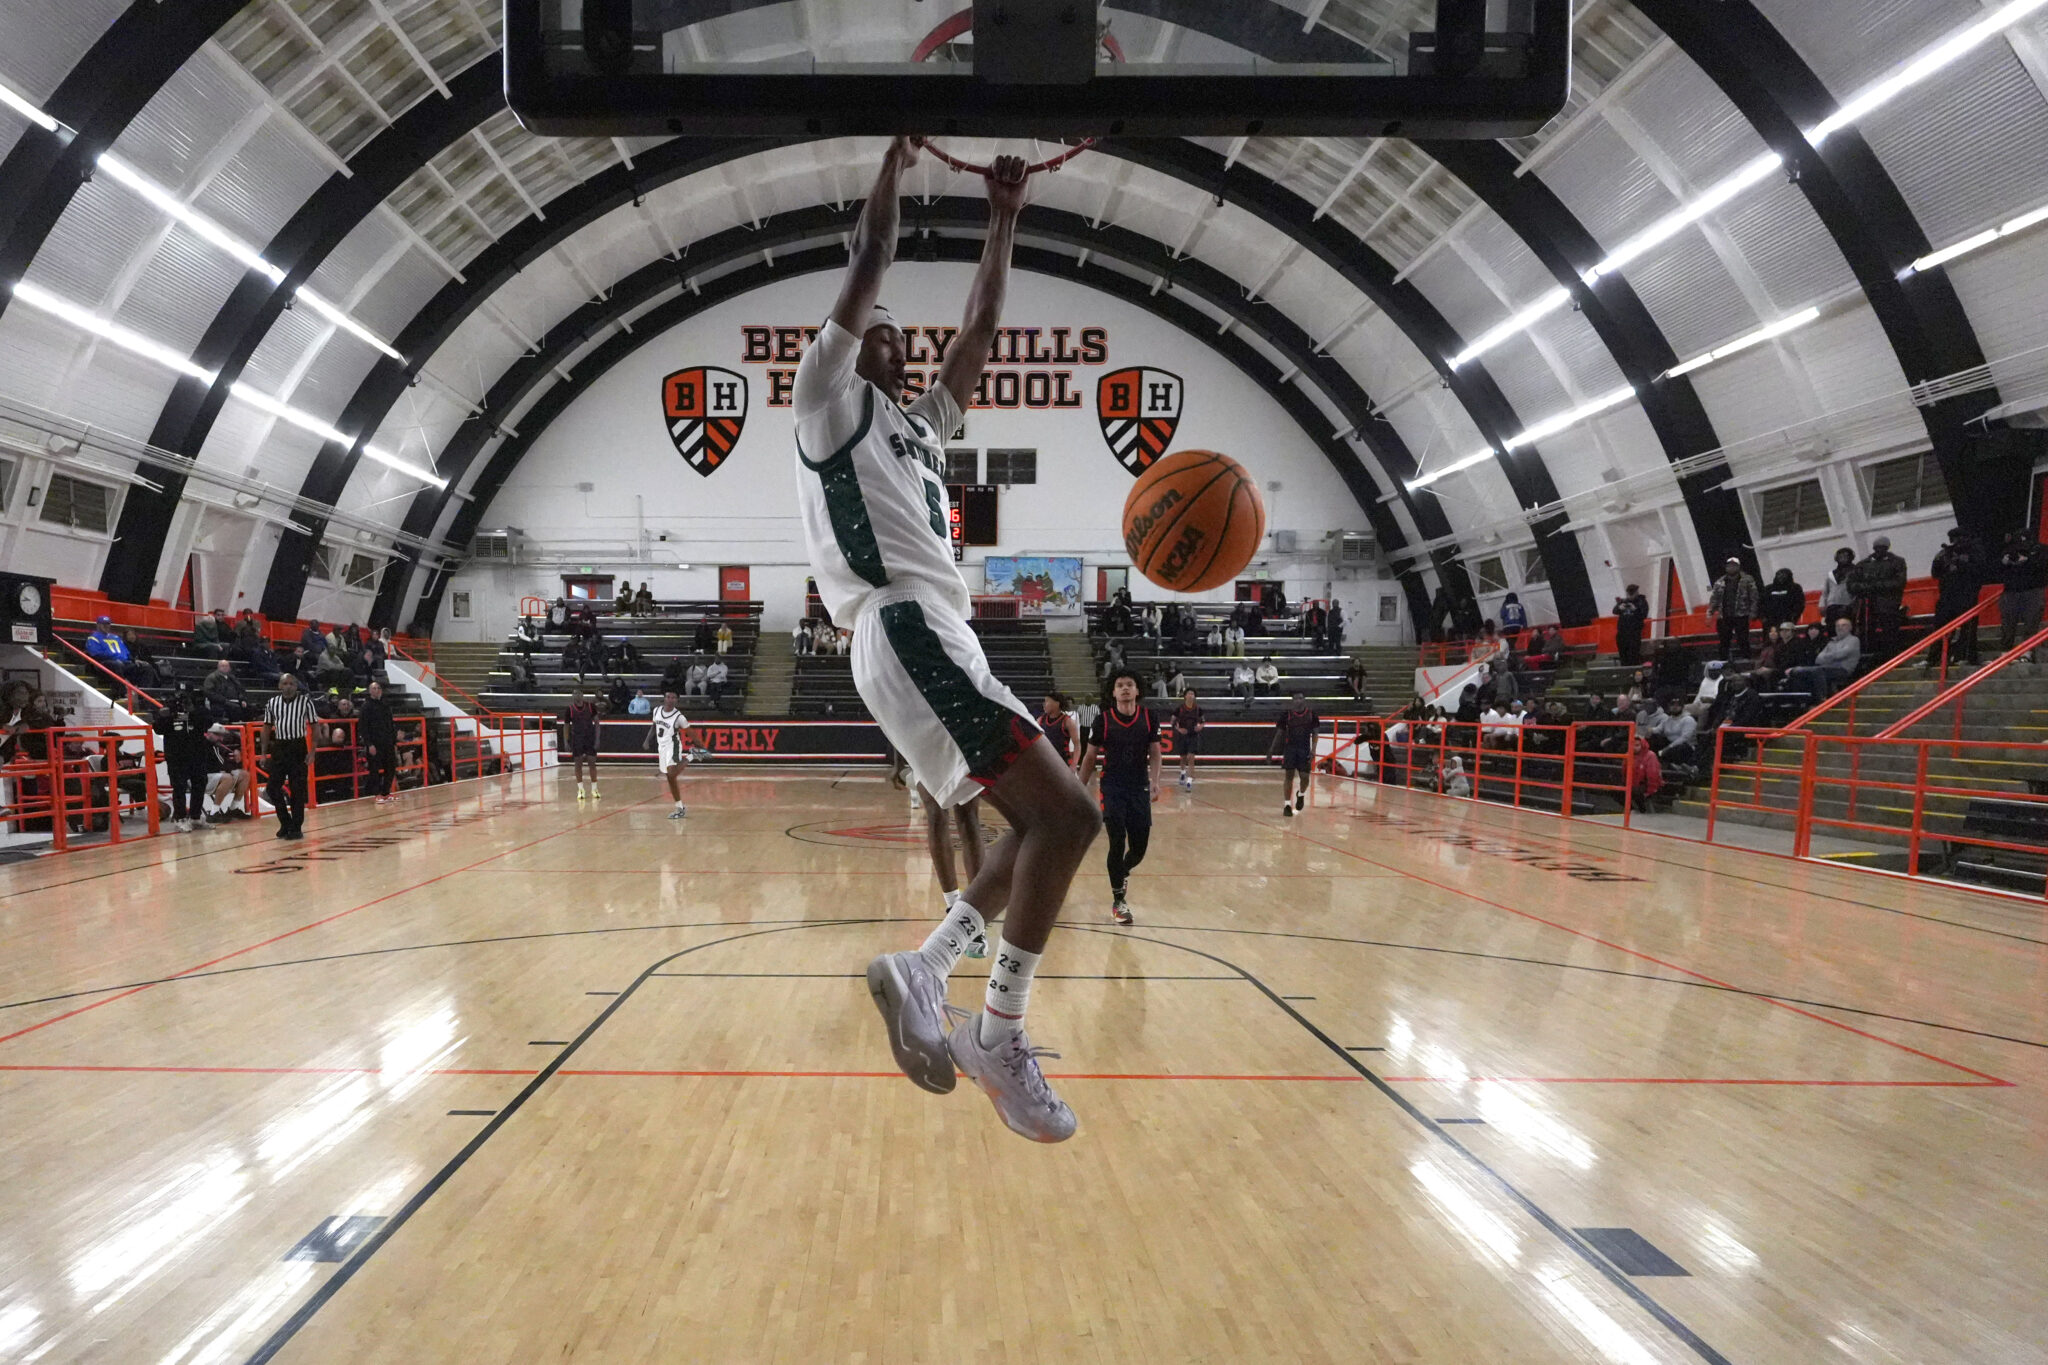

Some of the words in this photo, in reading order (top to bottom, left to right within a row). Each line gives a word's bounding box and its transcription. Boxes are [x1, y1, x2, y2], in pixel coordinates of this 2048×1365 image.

[741, 326, 959, 364] BELY
[675, 382, 695, 410] B
[713, 382, 737, 410] H
[1109, 383, 1130, 411] B
[1148, 383, 1172, 411] H
[1156, 524, 1206, 583] NCAA
[958, 916, 976, 936] 23
[998, 953, 1021, 973] 23
[989, 979, 1008, 992] 20
